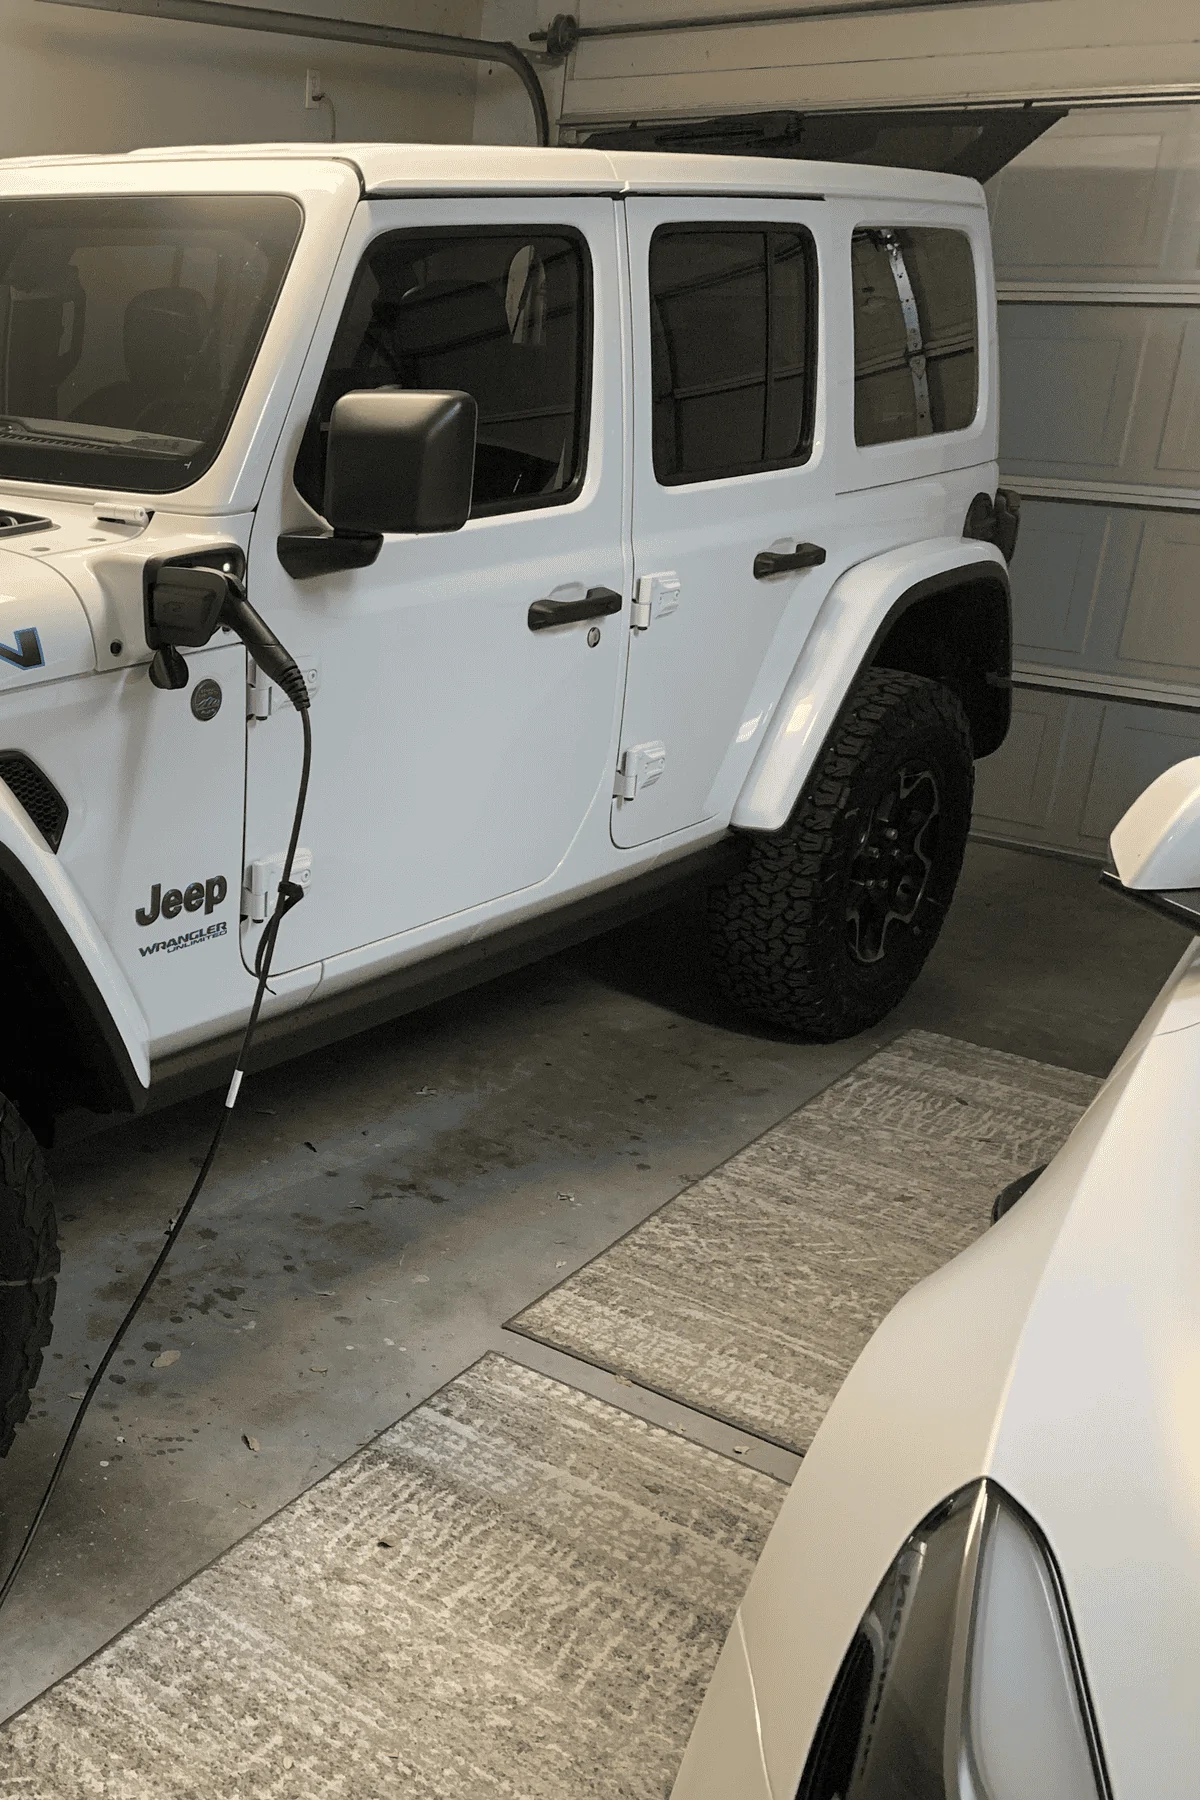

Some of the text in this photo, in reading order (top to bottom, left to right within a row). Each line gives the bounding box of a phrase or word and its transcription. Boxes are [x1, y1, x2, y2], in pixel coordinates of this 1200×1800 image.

[135, 875, 227, 926] Jeep
[138, 921, 227, 957] WRANGLER
[166, 930, 227, 953] UNLIMITED
